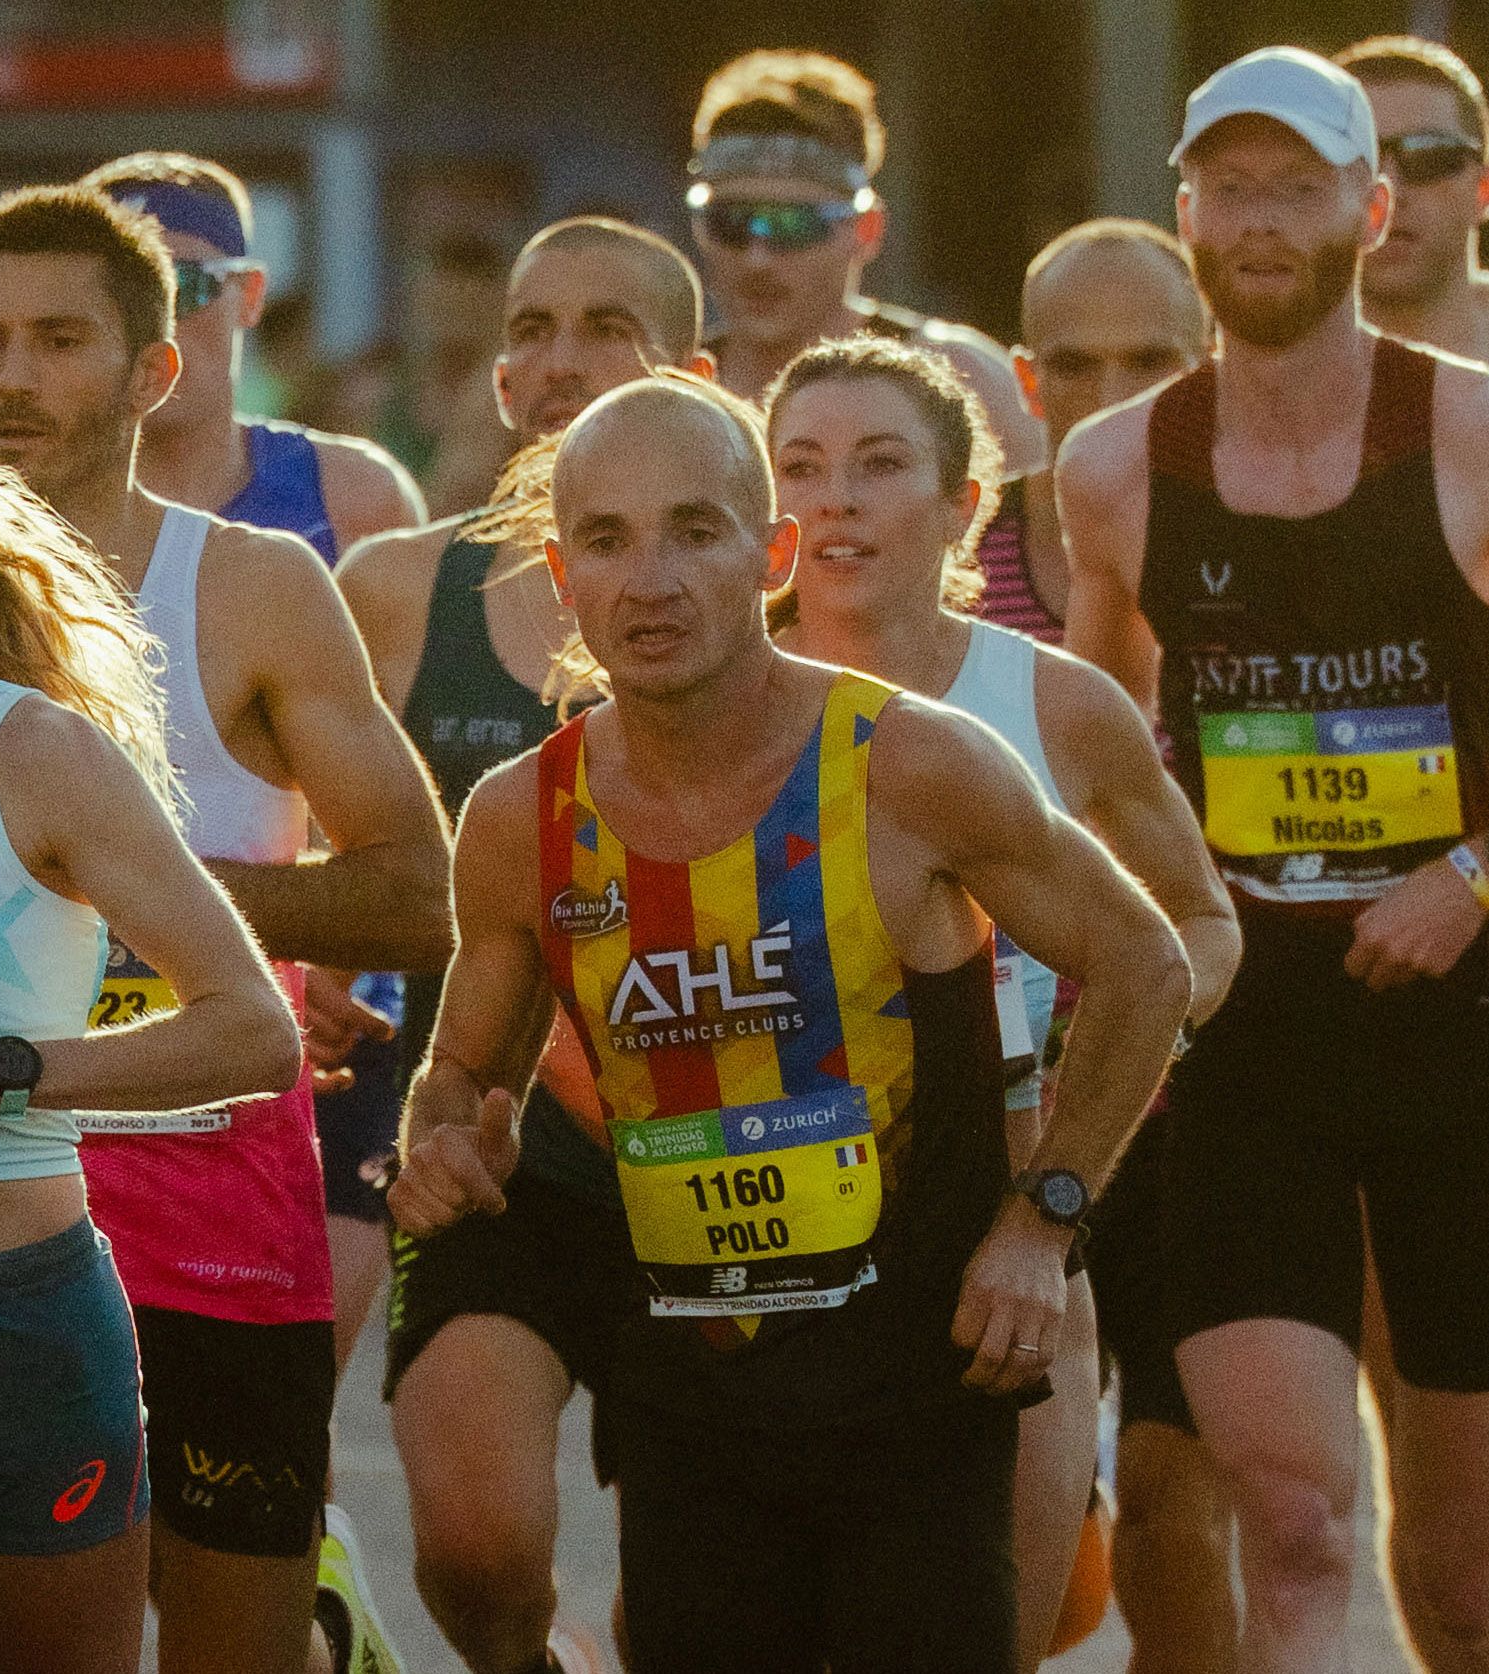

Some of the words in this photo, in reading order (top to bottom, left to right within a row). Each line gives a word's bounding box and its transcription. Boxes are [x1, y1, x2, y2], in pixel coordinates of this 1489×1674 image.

[1292, 640, 1429, 694] TOURS
[1278, 767, 1368, 802] 1139
[1272, 815, 1384, 844] Nicolas
[555, 904, 572, 918] Aix
[612, 1023, 726, 1050] PROVENCE
[735, 1013, 805, 1035] CLUBS
[91, 1118, 145, 1129] ALFONSO
[190, 1118, 215, 1128] 2025
[772, 1109, 837, 1132] ZURICH
[646, 1130, 705, 1148] TRINIDAD
[651, 1140, 708, 1157] ALFONSO
[685, 1165, 785, 1212] 1160
[839, 1182, 854, 1195] 01
[706, 1218, 789, 1255] POLO
[231, 1265, 295, 1289] running
[725, 1298, 770, 1310] TRINIDAD
[772, 1295, 818, 1308] ALFONSO
